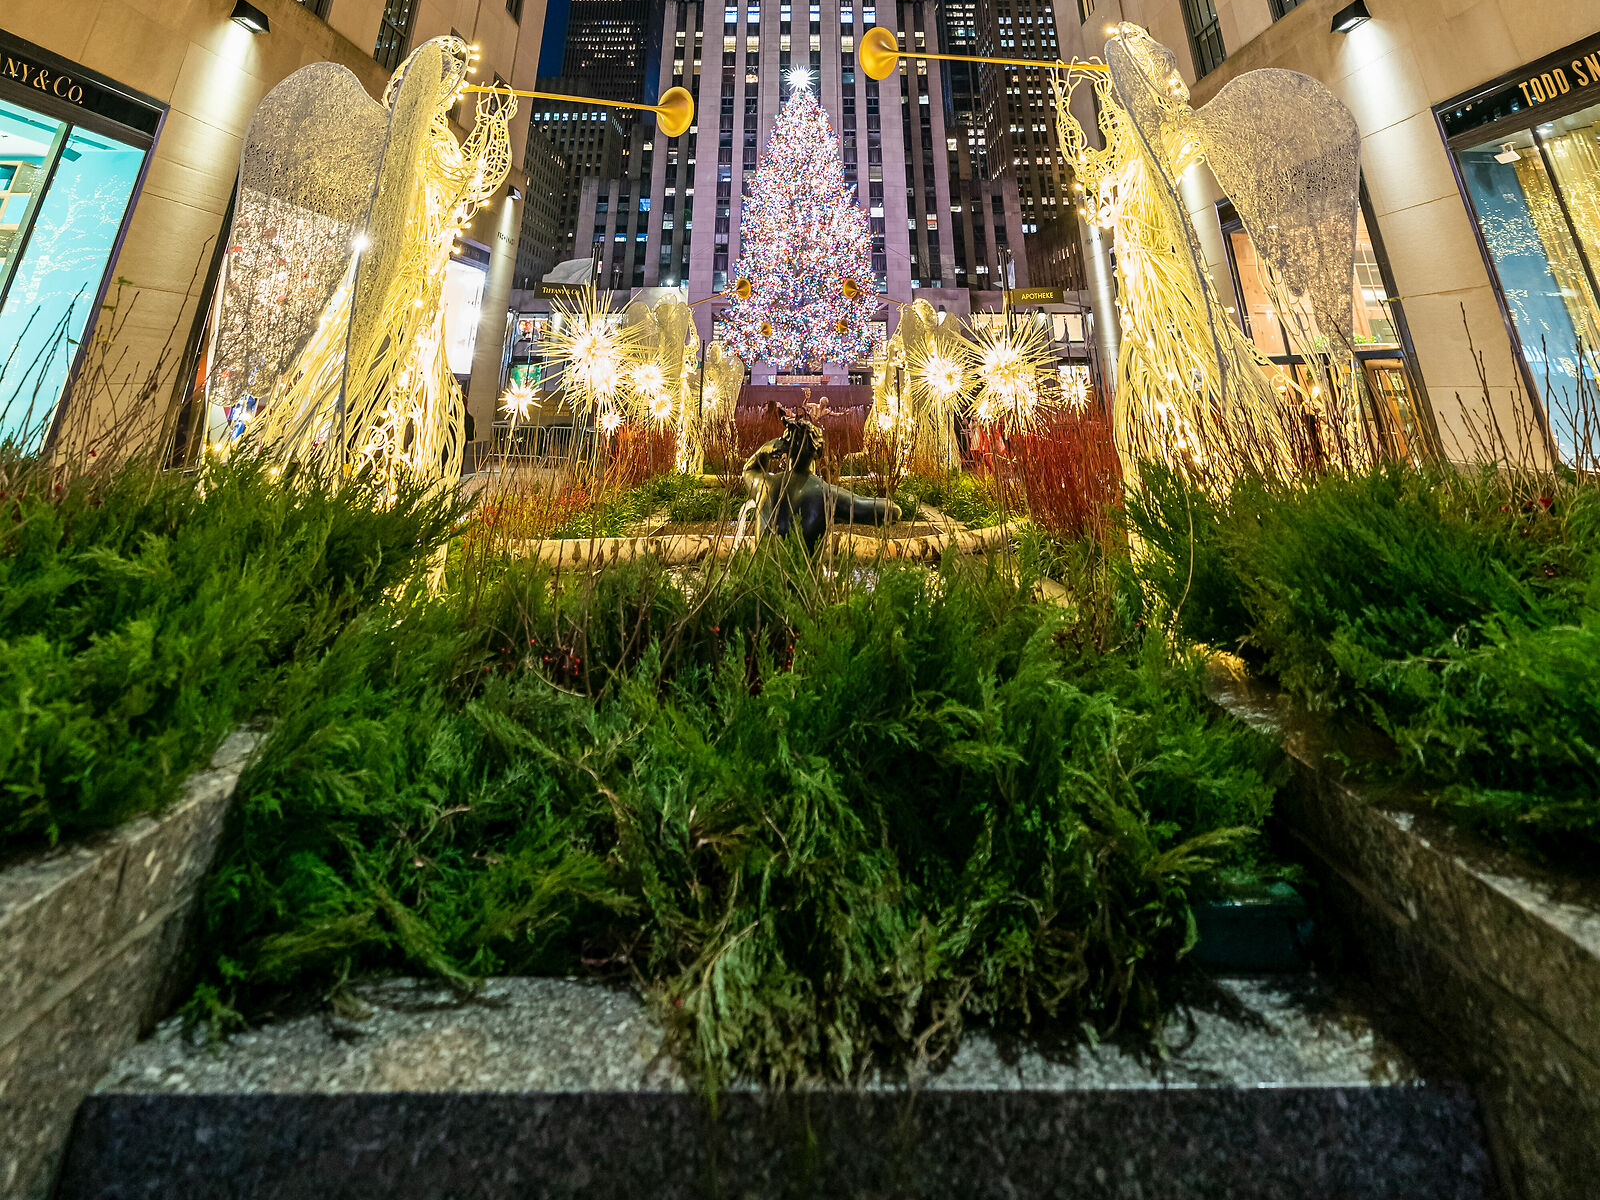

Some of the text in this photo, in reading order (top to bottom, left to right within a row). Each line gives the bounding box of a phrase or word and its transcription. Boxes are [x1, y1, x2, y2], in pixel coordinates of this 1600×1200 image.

[1518, 50, 1600, 107] TODD SN
[1021, 291, 1054, 300] APOTHEKE
